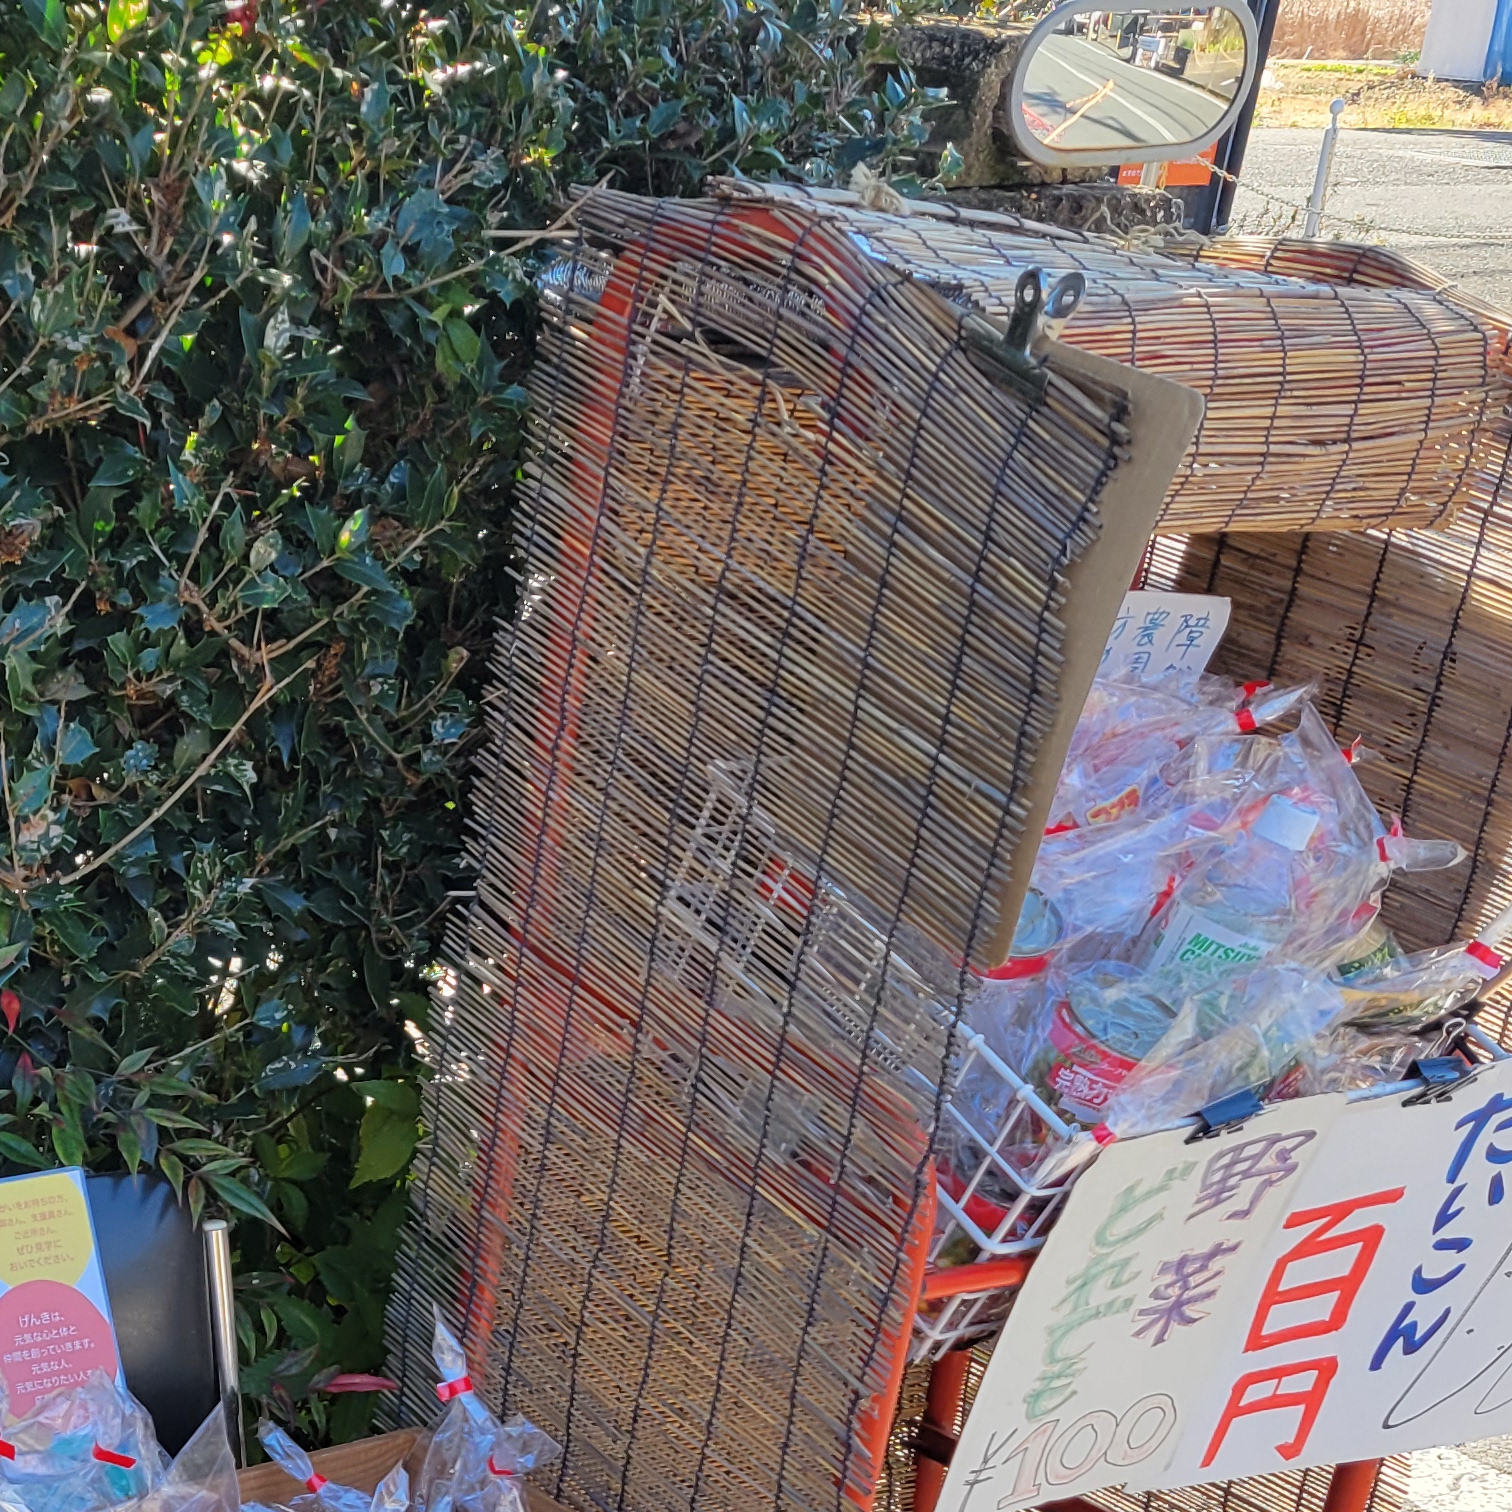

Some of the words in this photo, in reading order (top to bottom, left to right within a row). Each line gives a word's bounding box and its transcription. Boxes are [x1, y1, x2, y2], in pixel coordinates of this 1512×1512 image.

[18, 1311, 65, 1328] げんきは、
[1023, 1159, 1198, 1421] どれでも
[1130, 1129, 1318, 1347] 野菜
[1200, 1185, 1407, 1469] 百円
